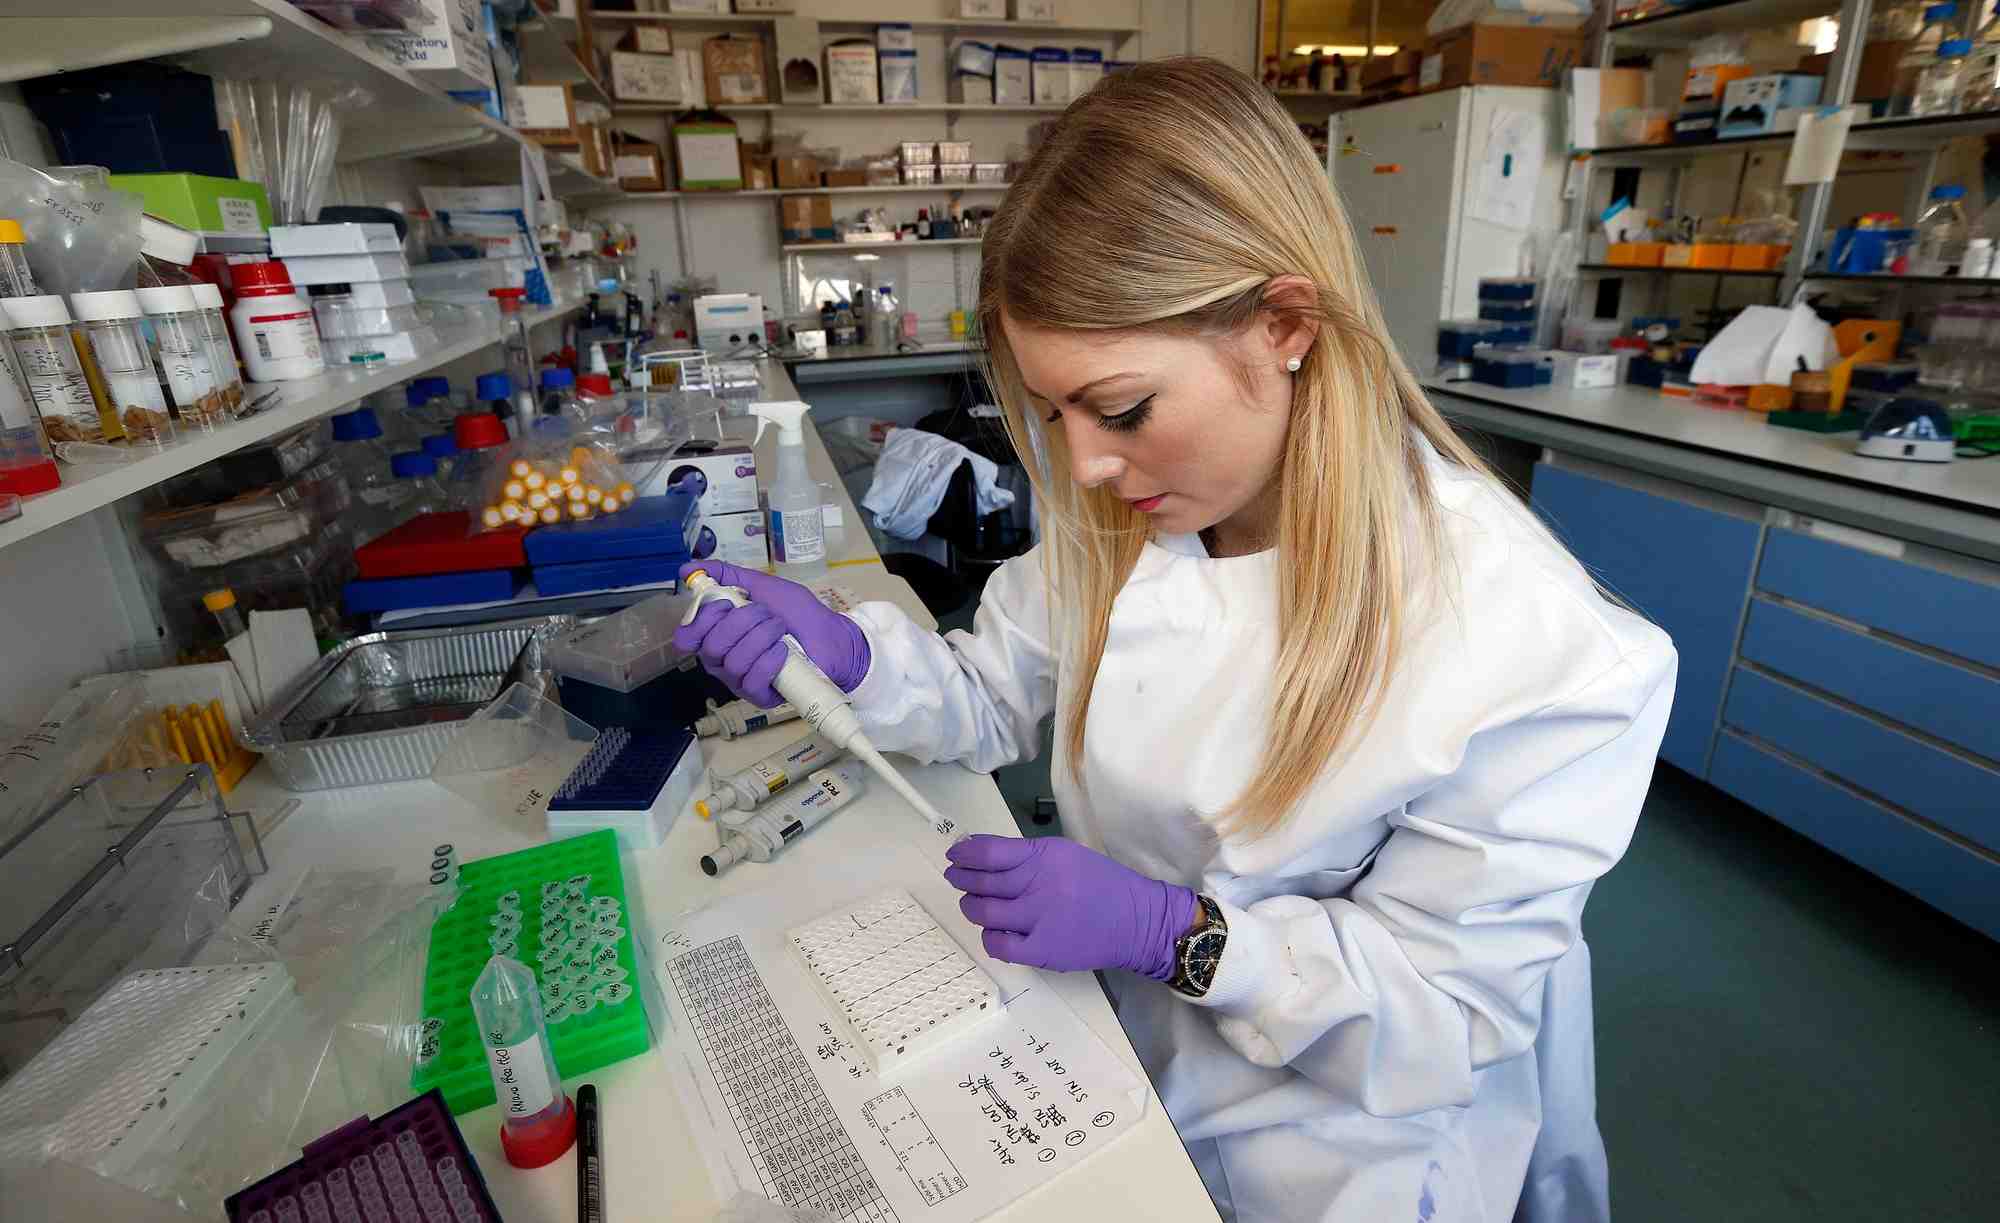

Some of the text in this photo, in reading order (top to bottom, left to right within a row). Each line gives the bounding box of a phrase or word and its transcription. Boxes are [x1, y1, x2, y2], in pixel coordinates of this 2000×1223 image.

[822, 779, 840, 796] PCR
[1045, 1059, 1066, 1075] CNT
[1065, 1080, 1088, 1103] STN
[981, 1104, 1001, 1123] CNT
[813, 1132, 826, 1150] VEGF
[766, 1154, 779, 1173] GAPDH
[777, 1151, 789, 1168] GFAP
[785, 1146, 798, 1162] ACTIN
[828, 1157, 843, 1177] VEGF
[790, 1177, 801, 1194] GFAP
[798, 1170, 812, 1189] ACTIN
[778, 1181, 792, 1202] GAPDH
[844, 1185, 856, 1204] VEGF
